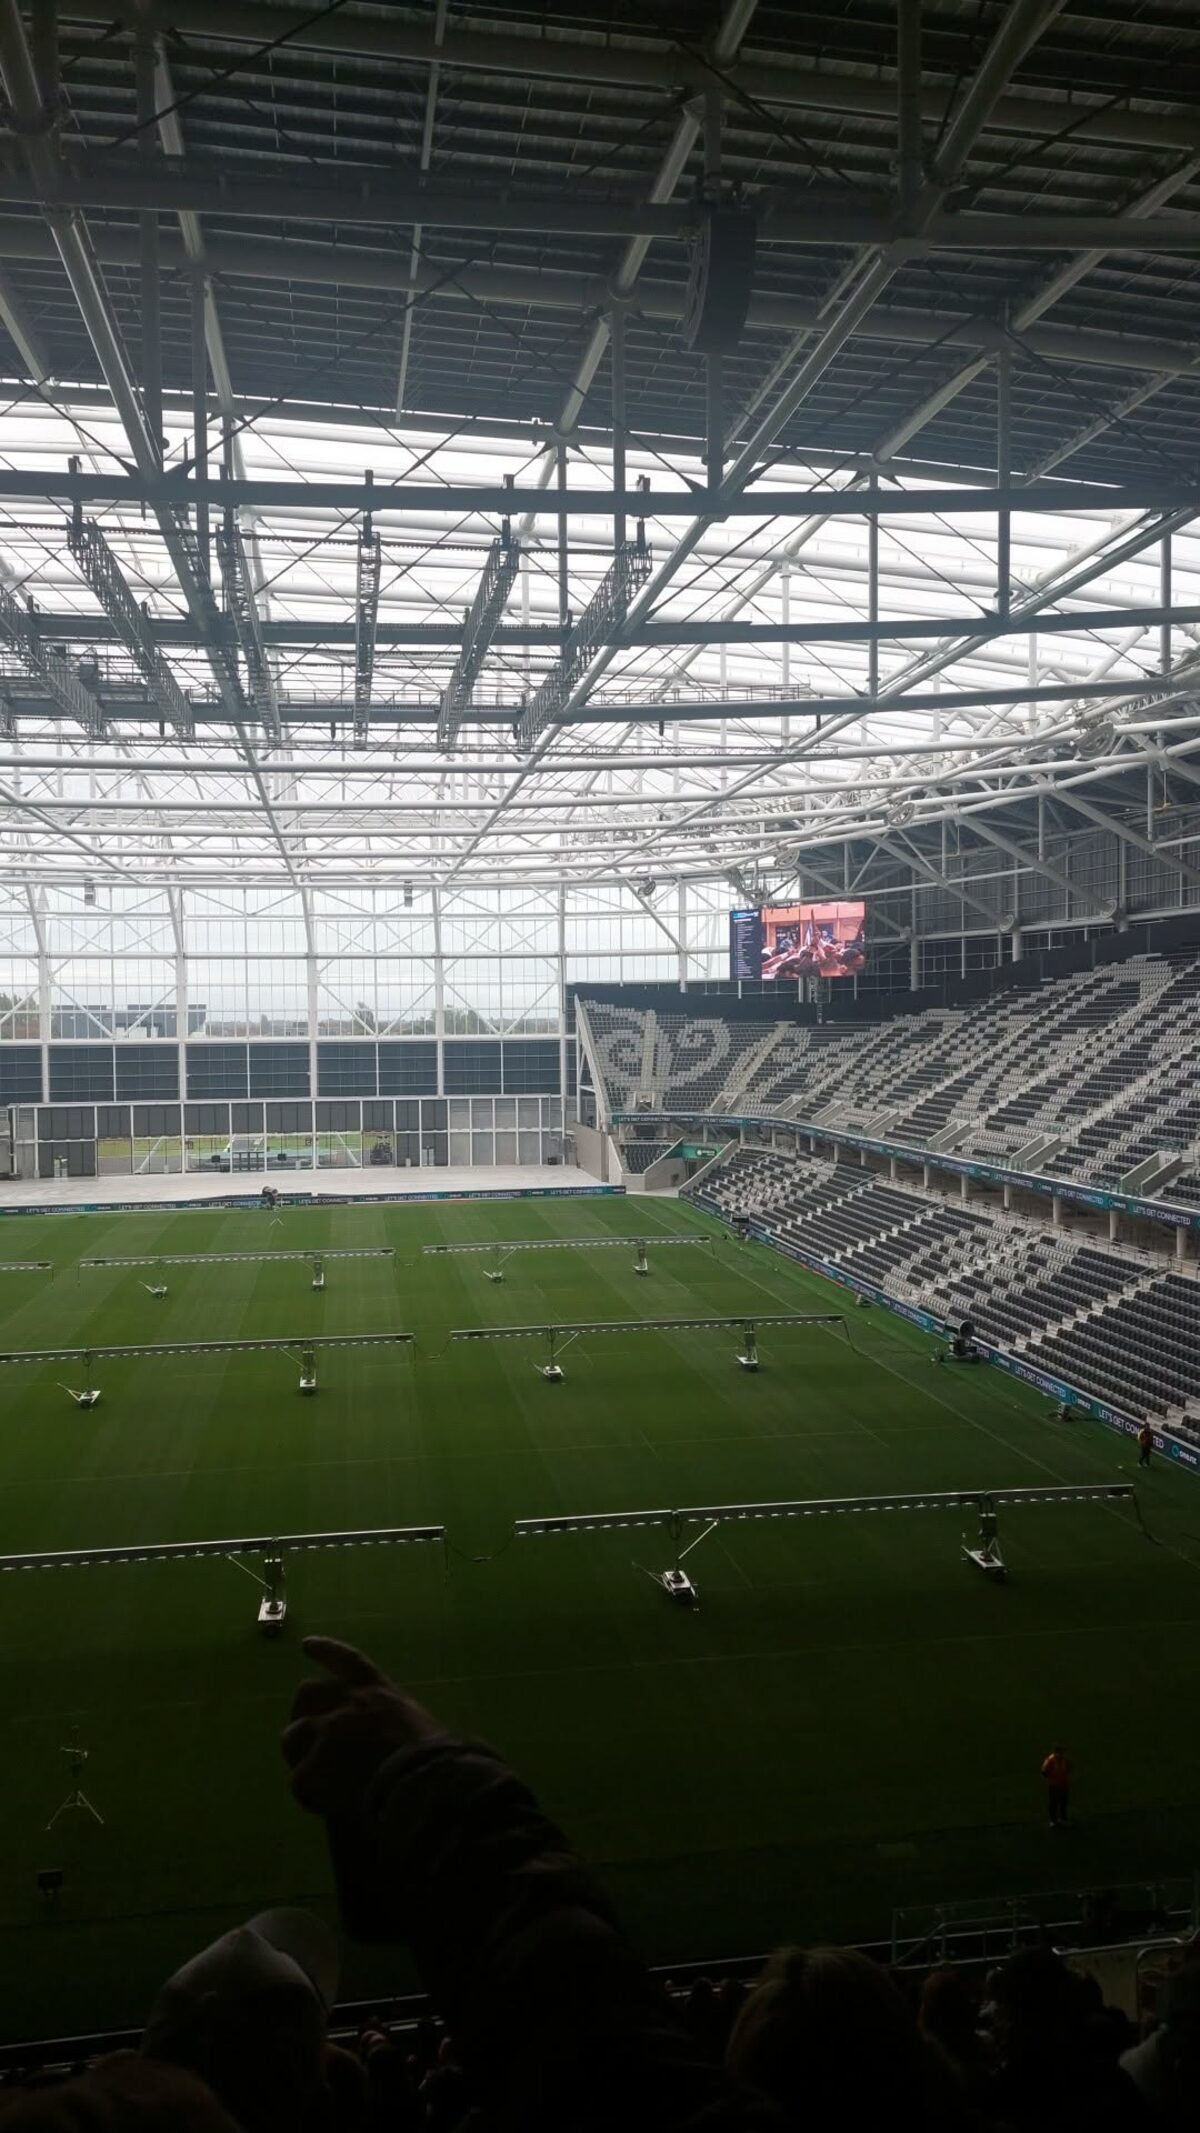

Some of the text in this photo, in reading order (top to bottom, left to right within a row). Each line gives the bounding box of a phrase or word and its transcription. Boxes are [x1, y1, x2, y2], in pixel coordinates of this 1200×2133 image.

[1132, 1203, 1146, 1215] LET'S
[1146, 1208, 1156, 1217] GET
[1156, 1210, 1190, 1225] CONNECTED
[1098, 1408, 1164, 1449] LET'S GET CONTED
